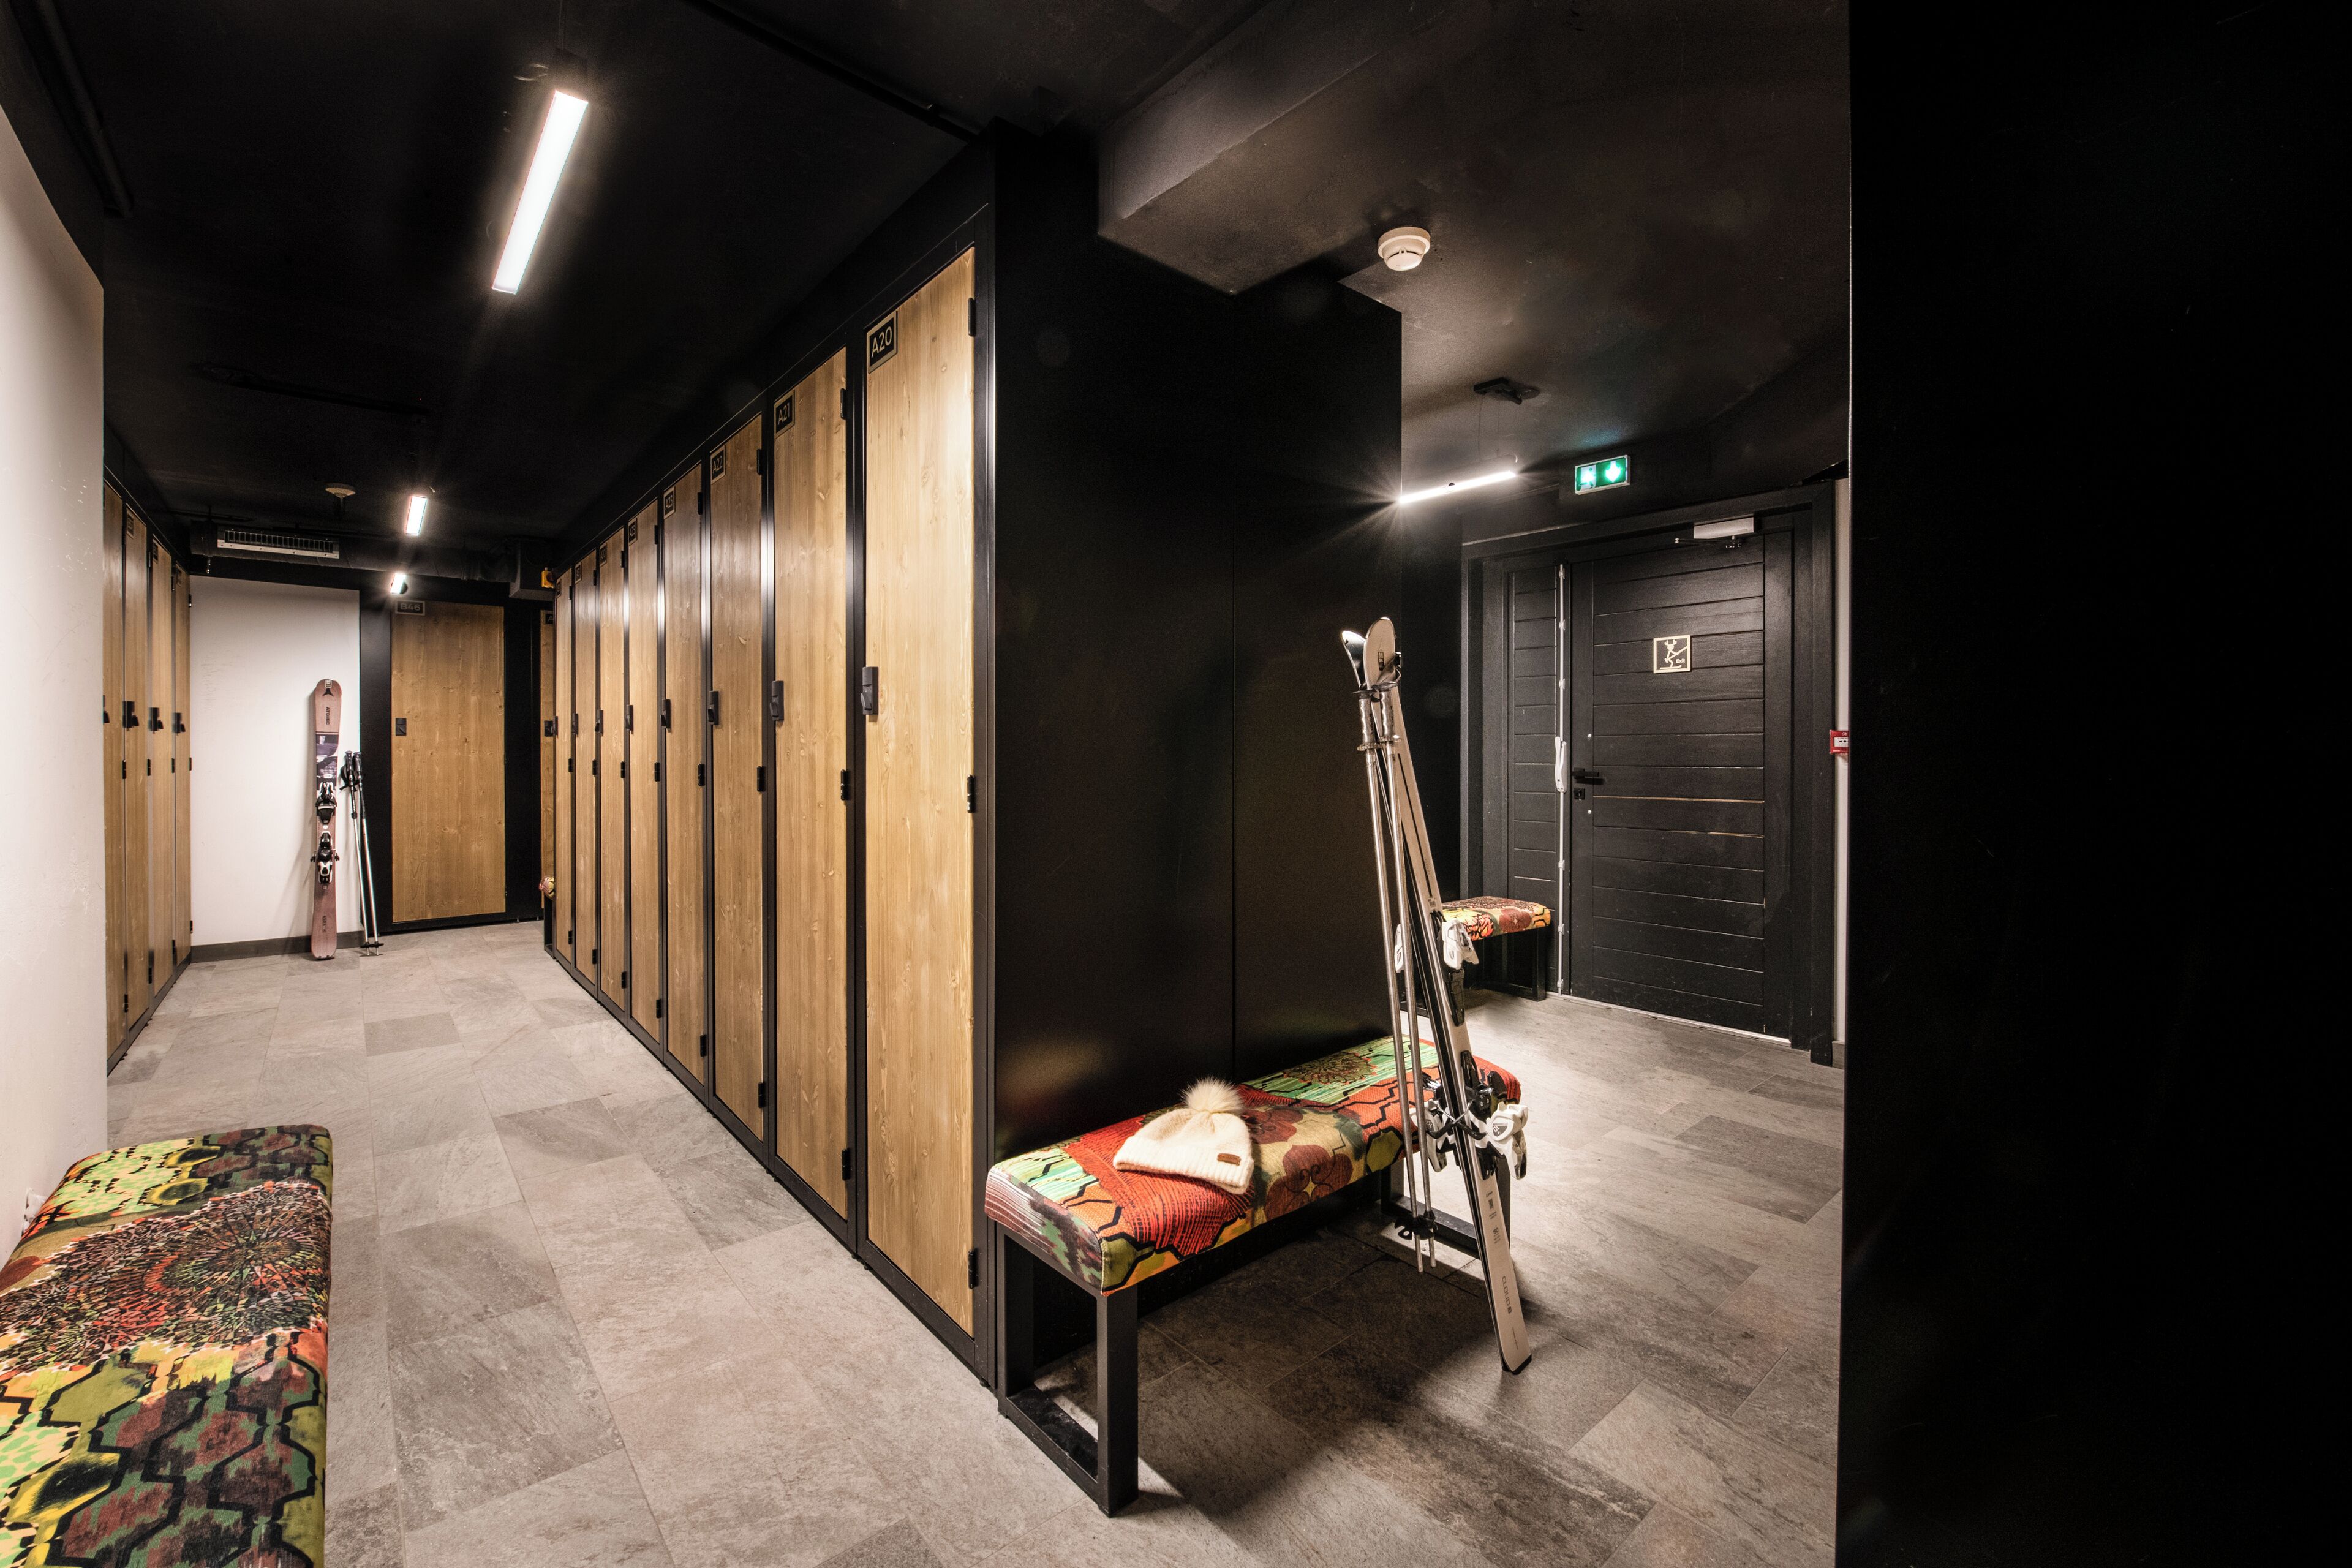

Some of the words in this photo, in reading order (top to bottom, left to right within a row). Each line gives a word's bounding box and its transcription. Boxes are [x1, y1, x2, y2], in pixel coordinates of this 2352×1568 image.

[871, 326, 892, 358] A20
[778, 402, 790, 425] A21
[713, 455, 723, 474] A22
[400, 603, 421, 611] B46
